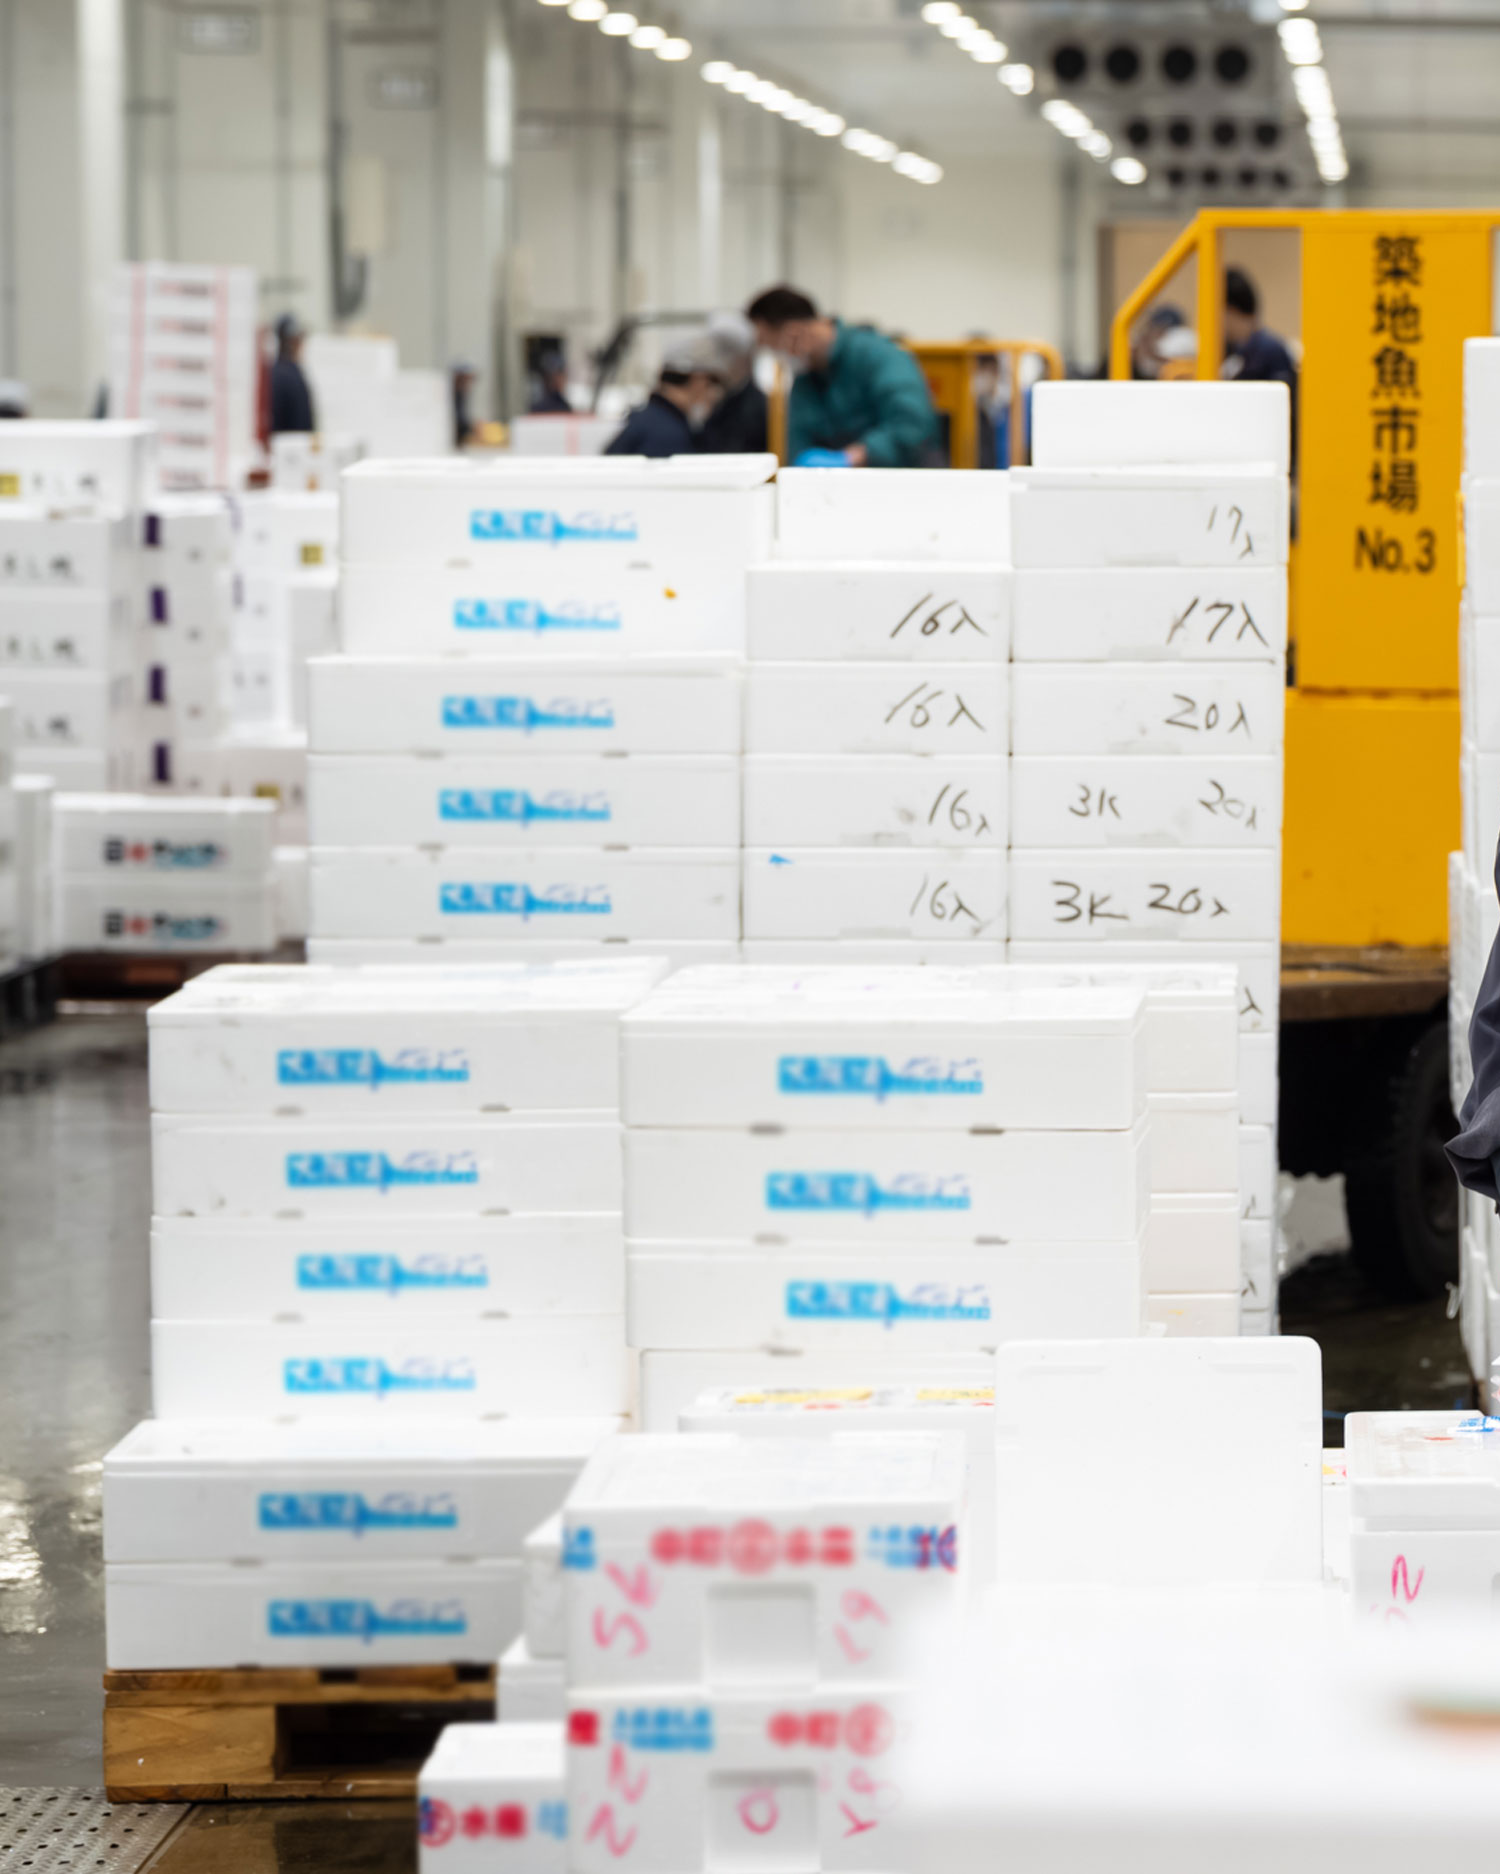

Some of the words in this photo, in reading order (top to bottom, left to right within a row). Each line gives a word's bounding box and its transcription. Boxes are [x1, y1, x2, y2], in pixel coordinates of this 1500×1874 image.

[1369, 234, 1423, 515] 築地魚市場
[1354, 525, 1437, 576] No.3
[1050, 881, 1130, 925] 3K
